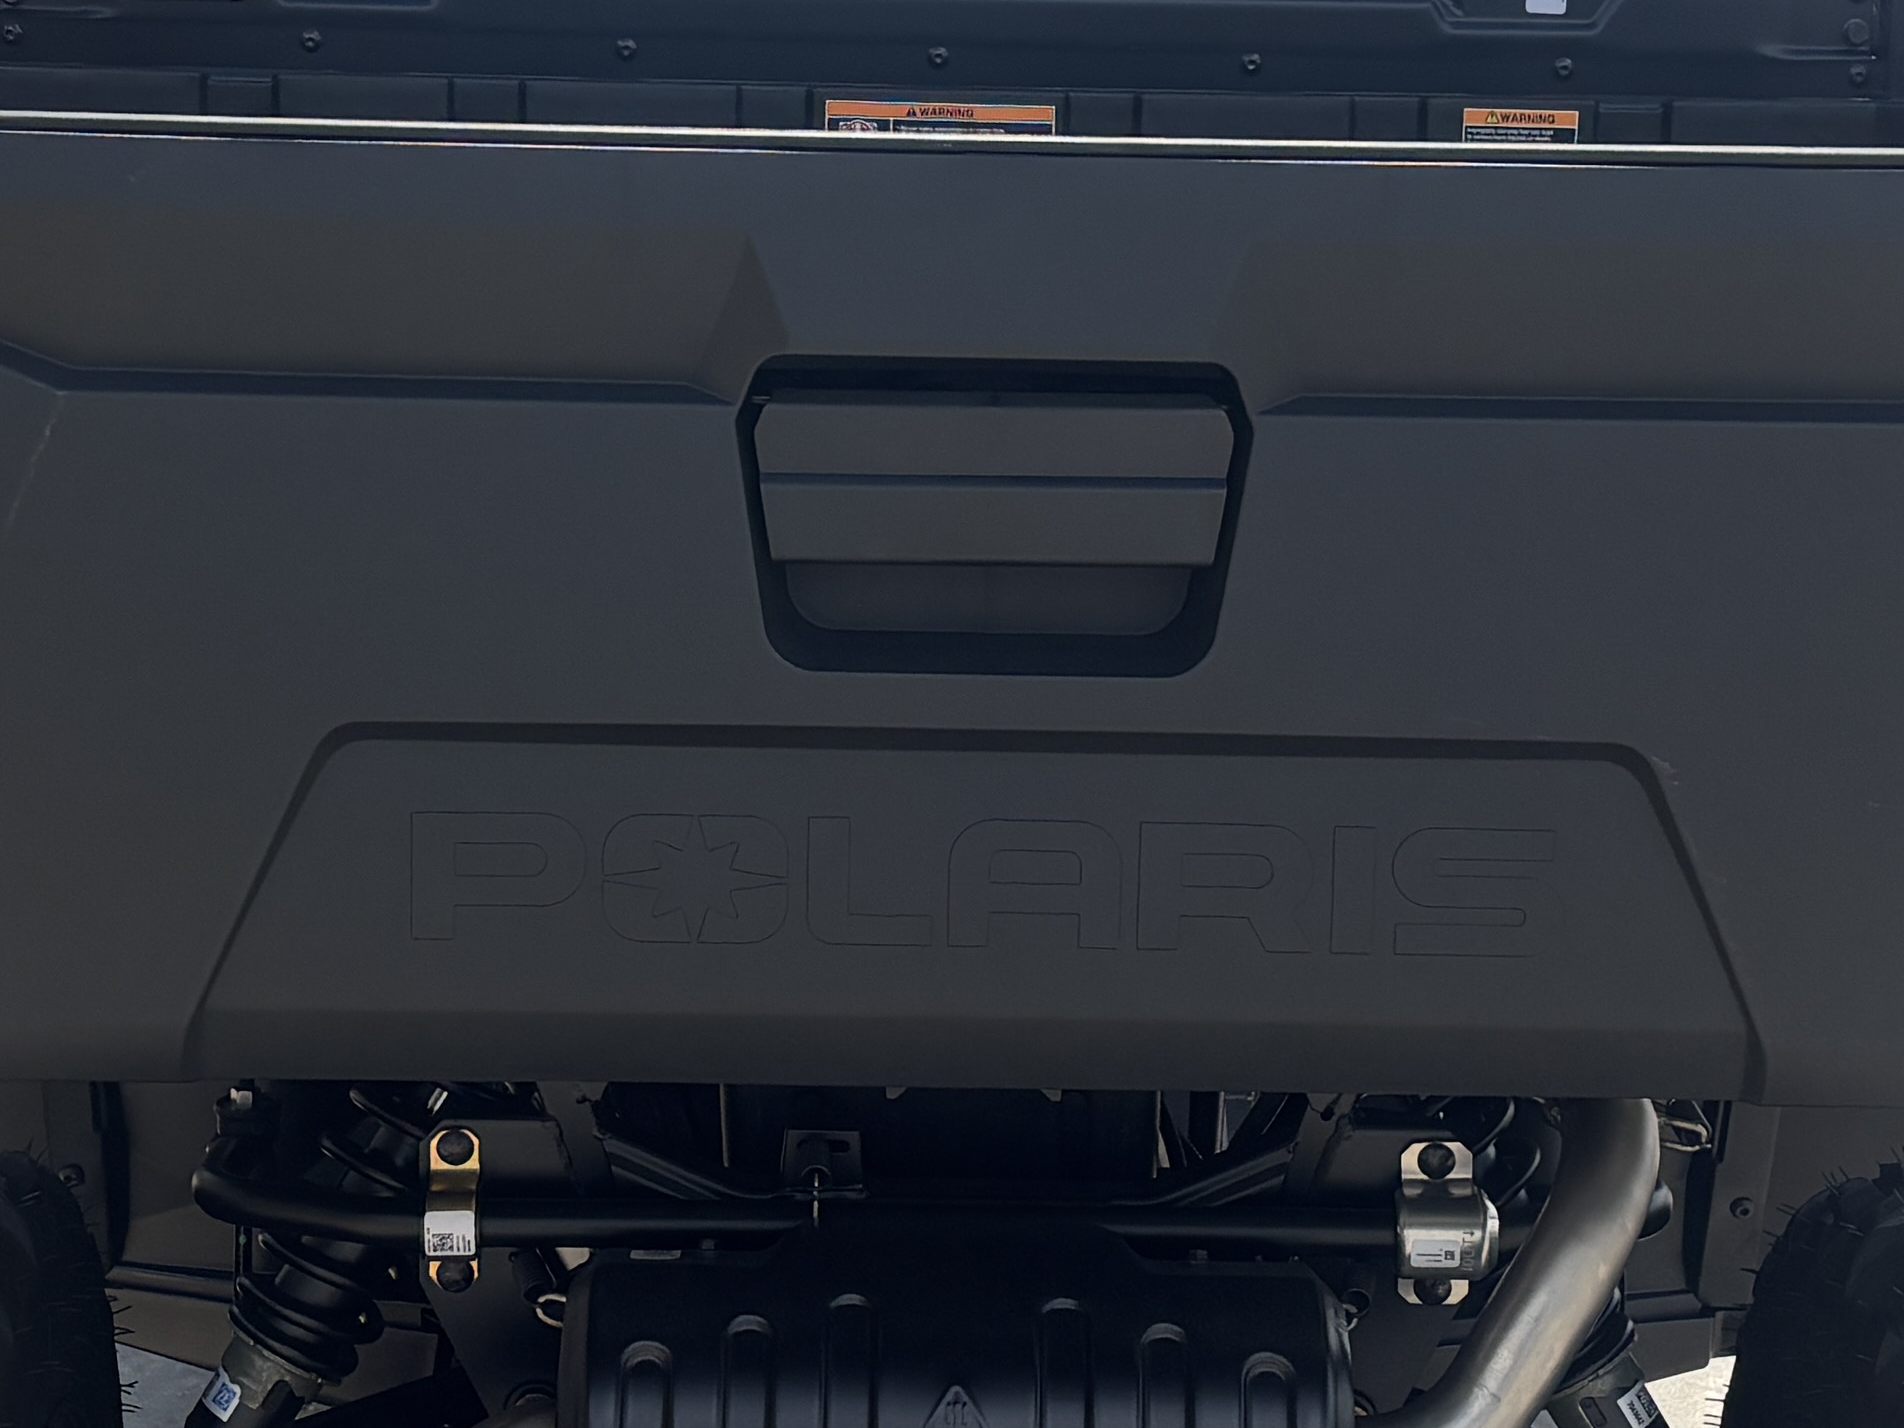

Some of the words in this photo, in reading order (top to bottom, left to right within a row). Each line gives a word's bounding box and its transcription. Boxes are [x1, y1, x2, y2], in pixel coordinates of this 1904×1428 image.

[919, 107, 974, 118] WARNING
[1500, 113, 1556, 125] WARNING
[411, 810, 1565, 957] POLARIS
